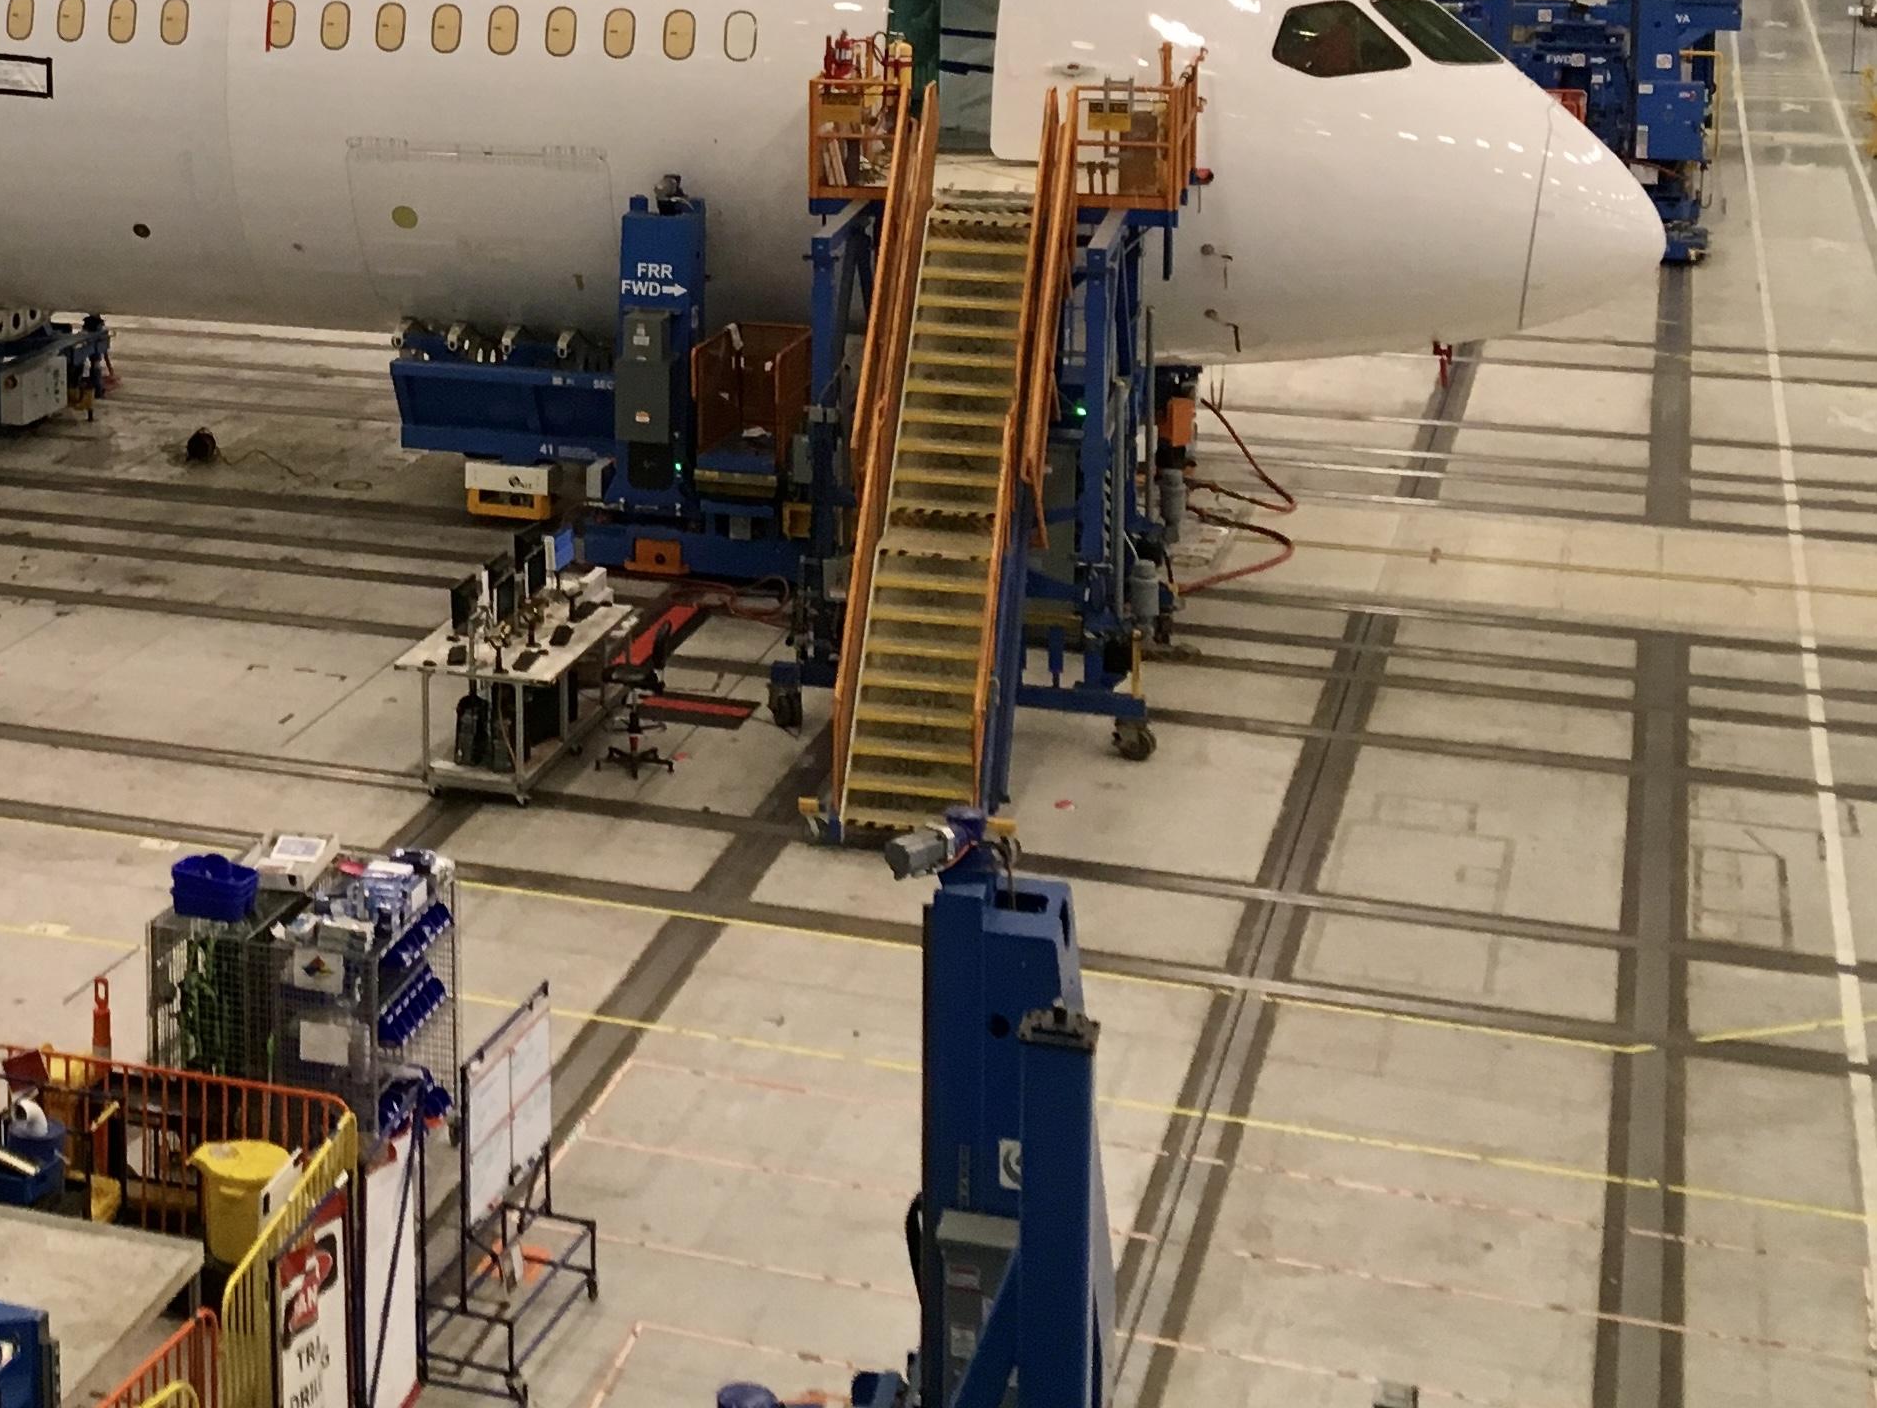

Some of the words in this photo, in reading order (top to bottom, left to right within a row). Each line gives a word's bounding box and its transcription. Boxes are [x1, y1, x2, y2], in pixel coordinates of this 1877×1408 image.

[637, 262, 673, 280] FRR
[621, 279, 661, 297] FWD
[539, 443, 553, 455] 41
